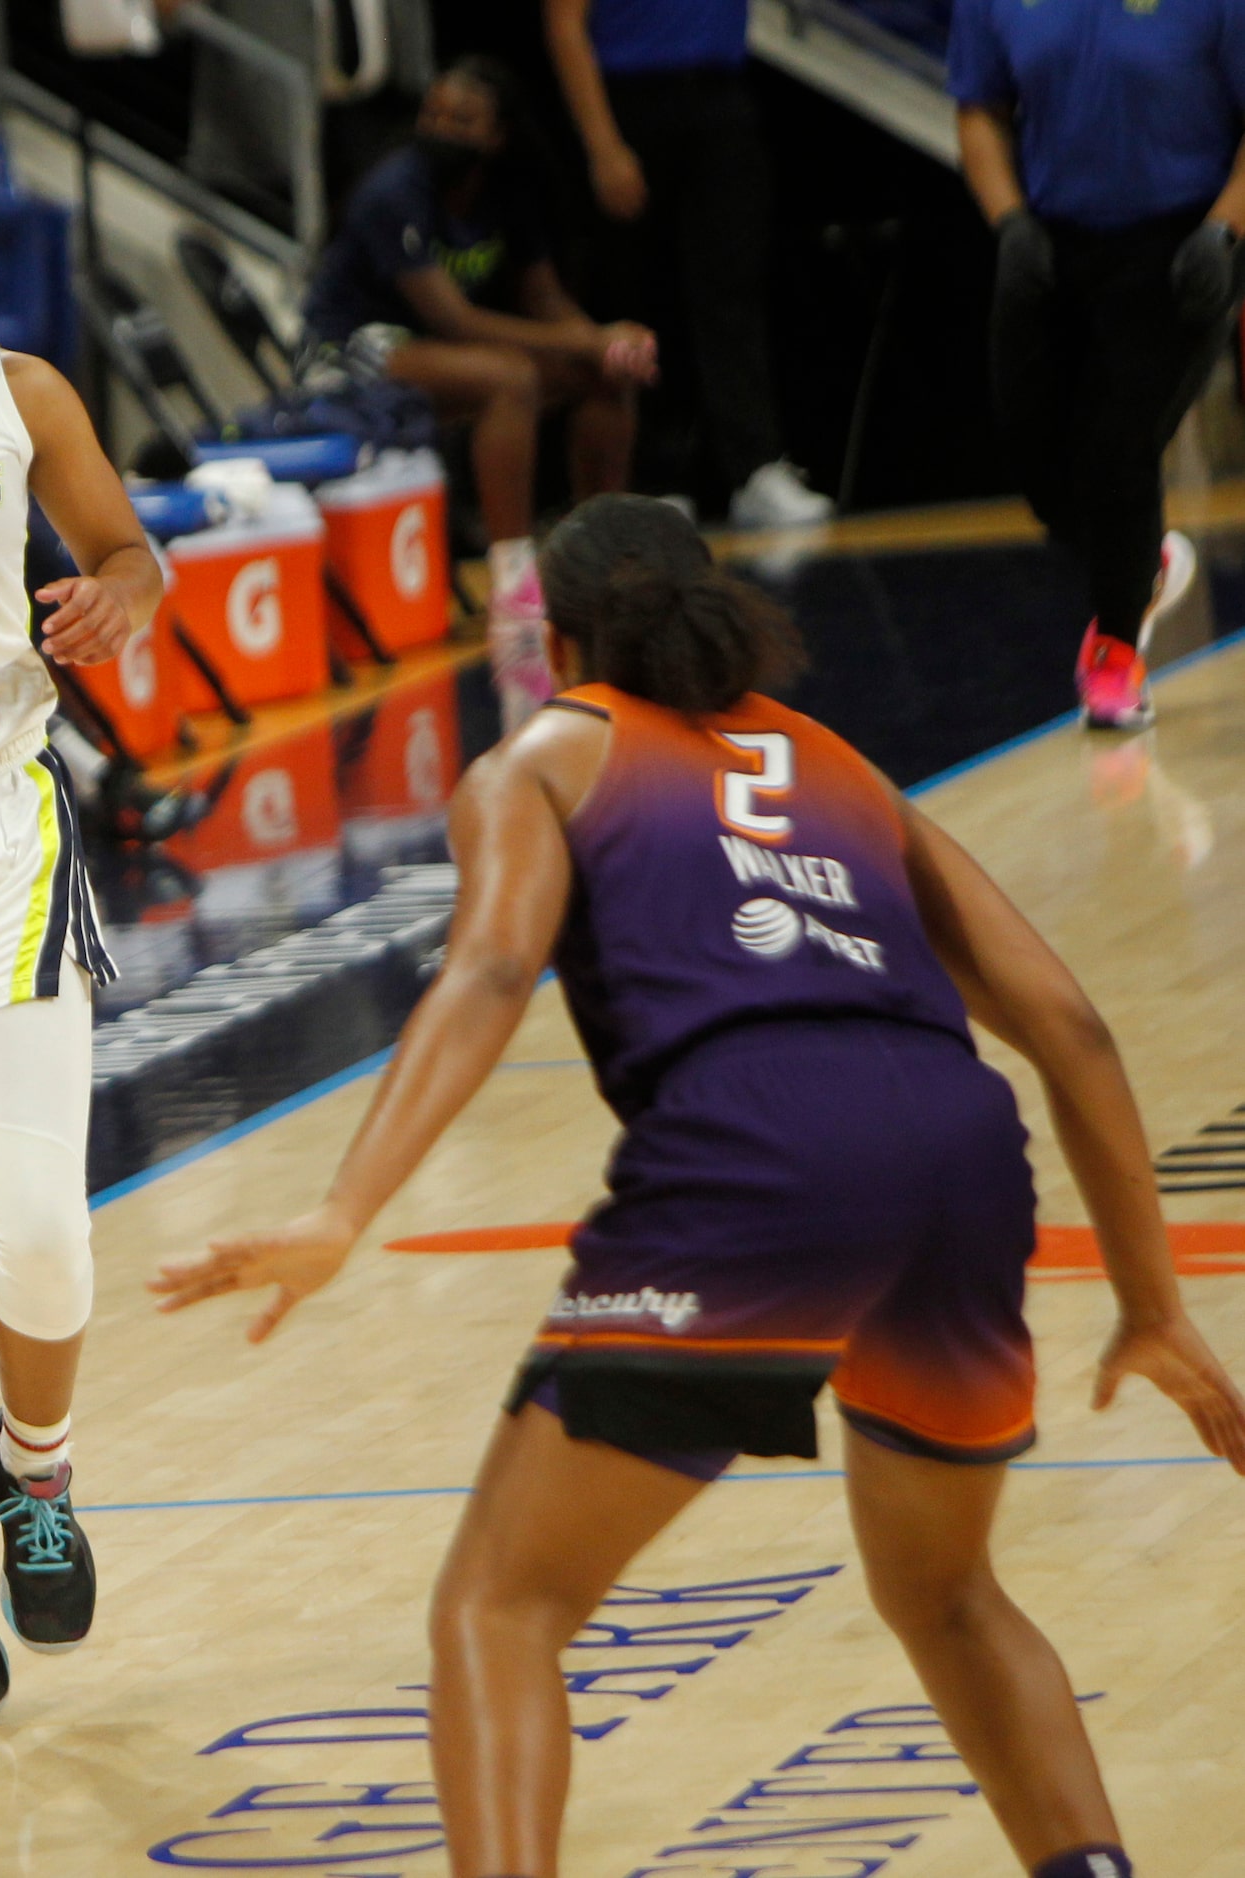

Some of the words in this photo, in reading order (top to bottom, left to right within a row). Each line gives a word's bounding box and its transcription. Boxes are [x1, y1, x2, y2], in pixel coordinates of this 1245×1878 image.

[389, 503, 427, 600] G
[224, 555, 281, 660] G
[715, 730, 794, 840] 2
[717, 833, 860, 910] WALKER
